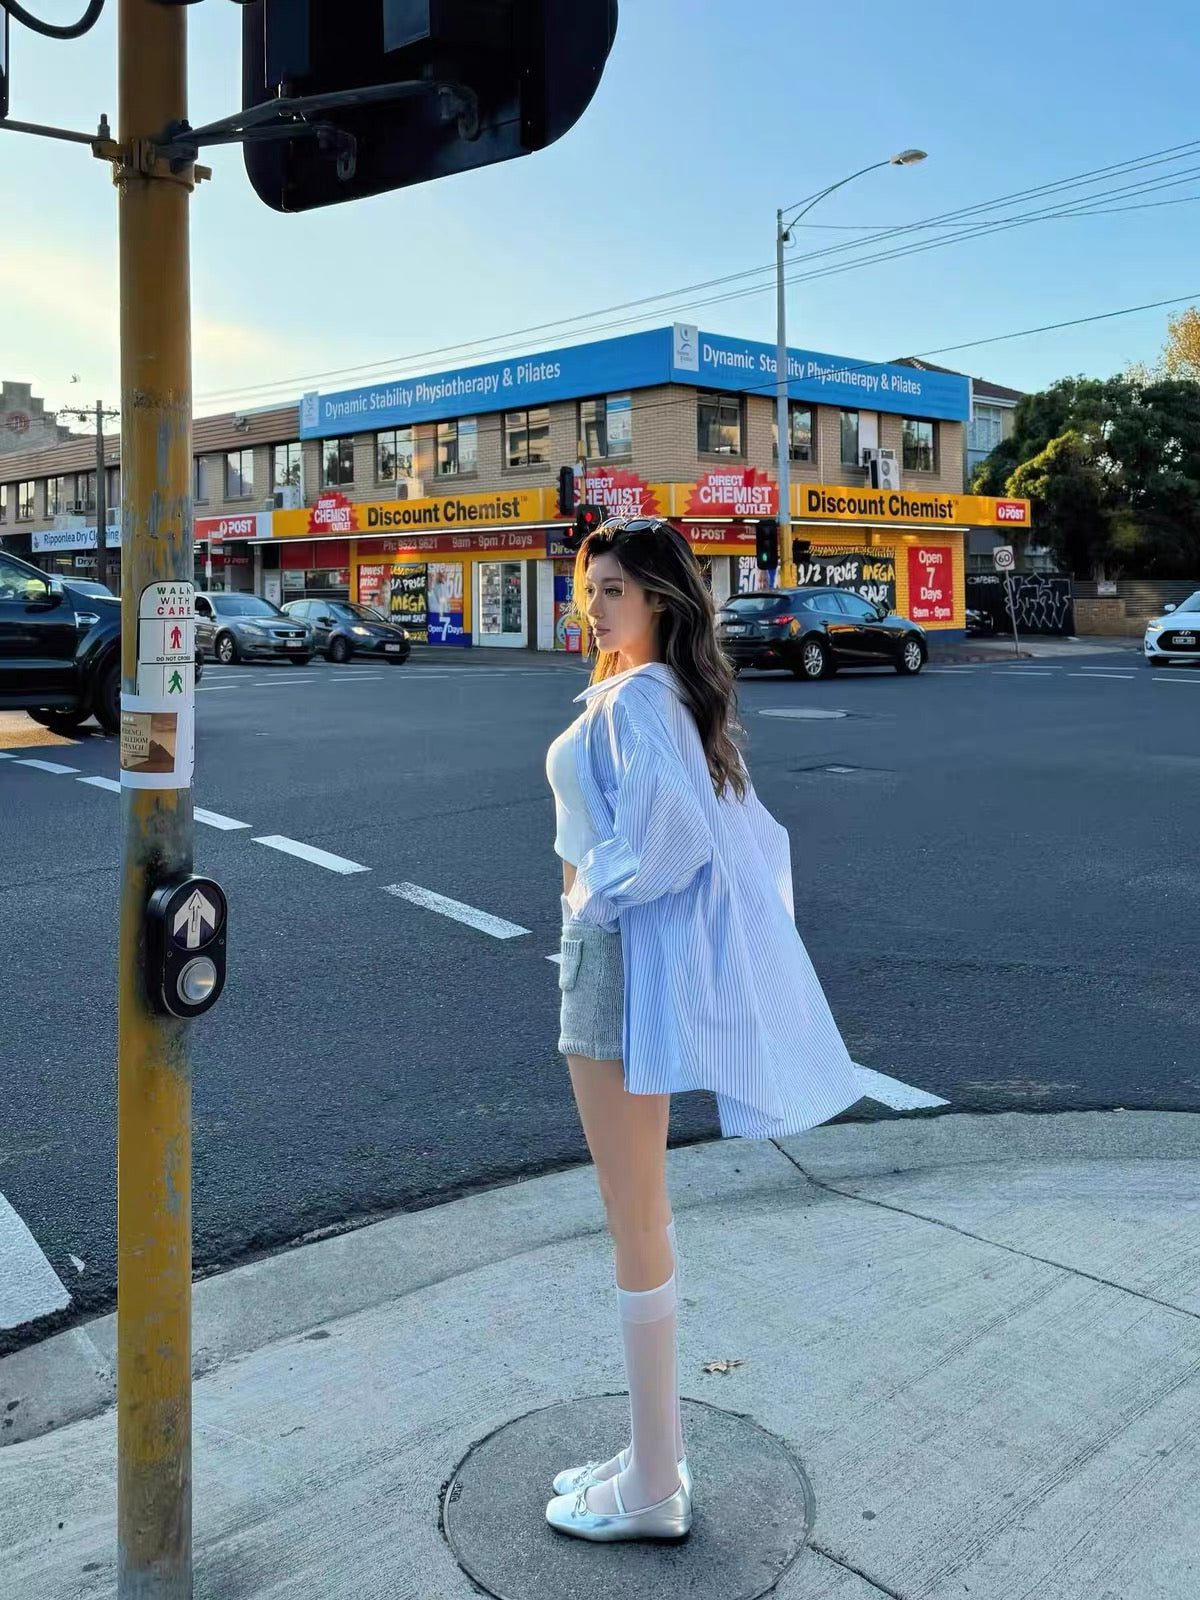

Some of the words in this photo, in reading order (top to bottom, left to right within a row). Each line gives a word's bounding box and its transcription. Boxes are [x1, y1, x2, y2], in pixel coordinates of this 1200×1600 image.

[703, 344, 755, 369] Dynamic
[760, 353, 804, 379] Stality
[807, 362, 879, 392] Physiotherapy
[880, 373, 889, 390] &
[891, 375, 922, 395] Pilates
[325, 395, 367, 419] Dynamic
[370, 388, 412, 410] Stability
[416, 374, 499, 404] Physiotherapy
[502, 367, 513, 387] &
[517, 362, 561, 385] Pilates
[708, 475, 744, 486] DIRECT
[699, 486, 772, 504] CHEMIST
[367, 504, 440, 527] Discount
[443, 496, 520, 522] Chemist
[735, 503, 772, 515] OUTLET
[808, 489, 885, 515] Discount
[888, 495, 953, 519] Chemist
[314, 507, 351, 524] CHEMIST
[1005, 508, 1025, 520] POST
[228, 520, 253, 534] POST
[701, 528, 726, 540] POST
[44, 532, 75, 547] Ripponlea
[76, 531, 88, 544] Dry
[452, 536, 470, 548] 9am
[479, 535, 498, 549] 9pm
[501, 534, 506, 544] 7
[508, 533, 532, 546] Days
[77, 558, 93, 567] Dry
[919, 550, 942, 566] Open
[998, 553, 1010, 563] 60
[360, 564, 384, 576] lowest
[798, 563, 821, 585] 1/2
[826, 562, 859, 585] PRICE
[863, 563, 895, 581] MEGA
[926, 567, 935, 588] 7
[360, 576, 378, 589] price
[402, 576, 426, 590] PRICE
[920, 586, 942, 602] Days
[391, 593, 426, 612] MEGA
[157, 607, 191, 615] CARE
[913, 606, 929, 618] 9am
[934, 606, 951, 619] 9pm
[428, 624, 442, 634] Open
[439, 616, 451, 641] 7
[448, 624, 464, 635] Days
